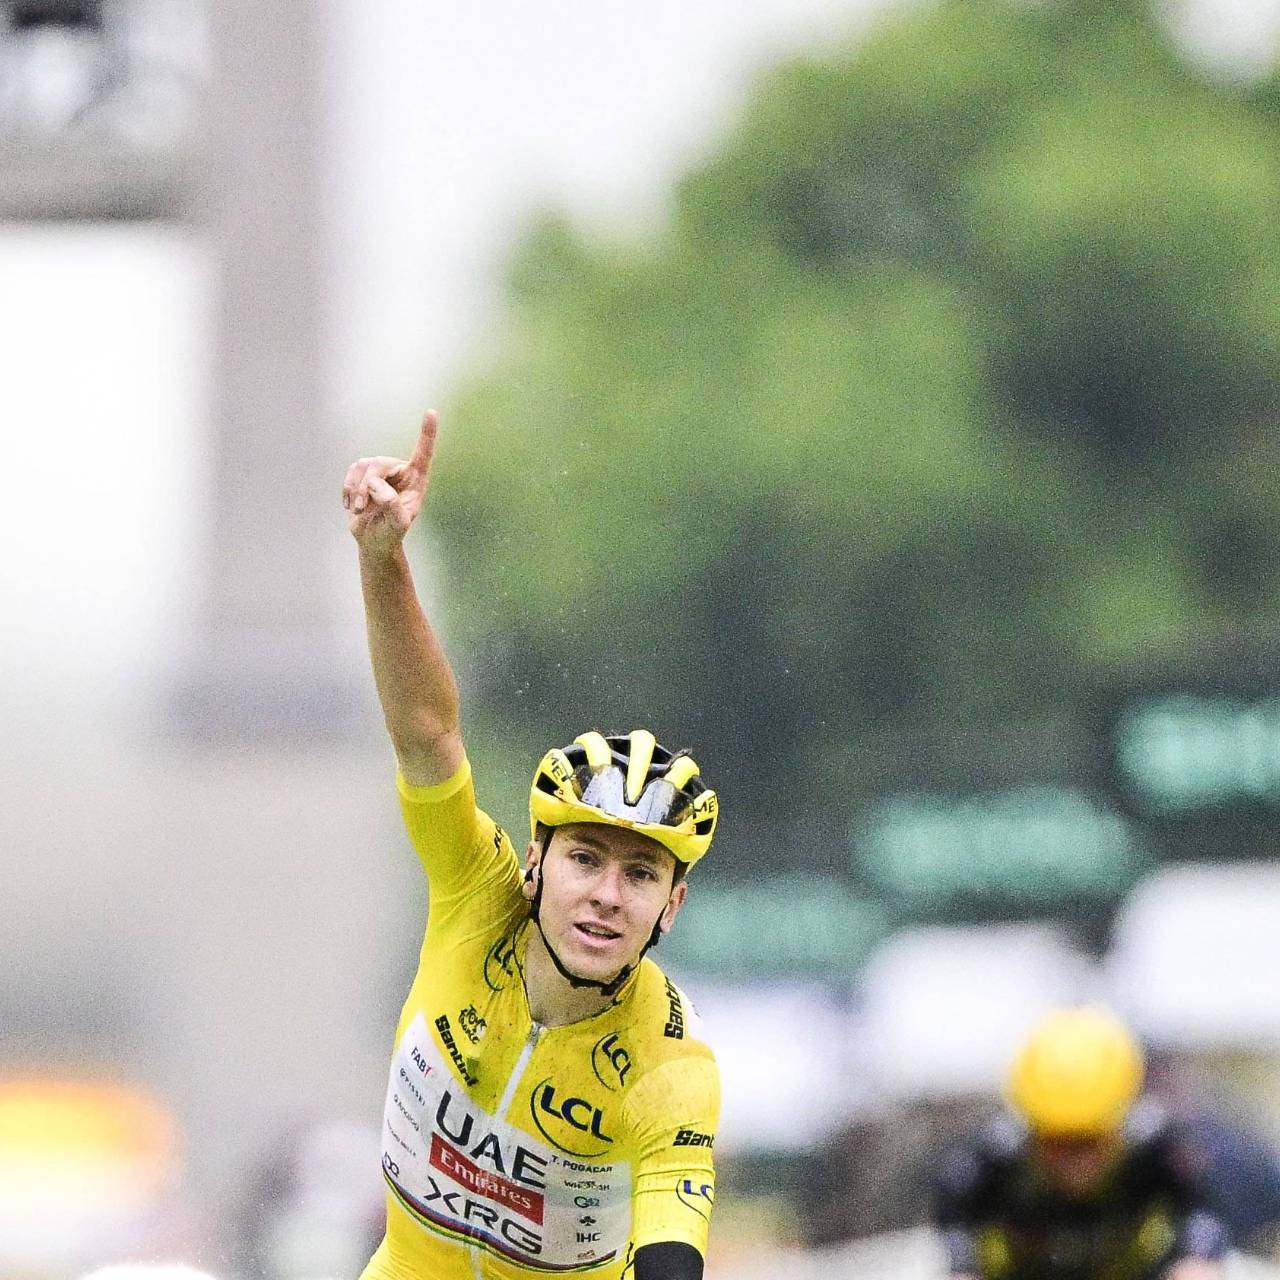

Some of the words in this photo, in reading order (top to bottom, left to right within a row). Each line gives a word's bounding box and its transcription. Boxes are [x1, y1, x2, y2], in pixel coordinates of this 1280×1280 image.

[435, 1014, 480, 1087] Santini
[602, 1034, 632, 1088] LCL
[436, 1089, 548, 1190] UAE
[540, 1084, 614, 1144] LCL
[439, 1147, 532, 1210] Emirates
[423, 1175, 543, 1255] XRG
[575, 1232, 602, 1243] IHC
